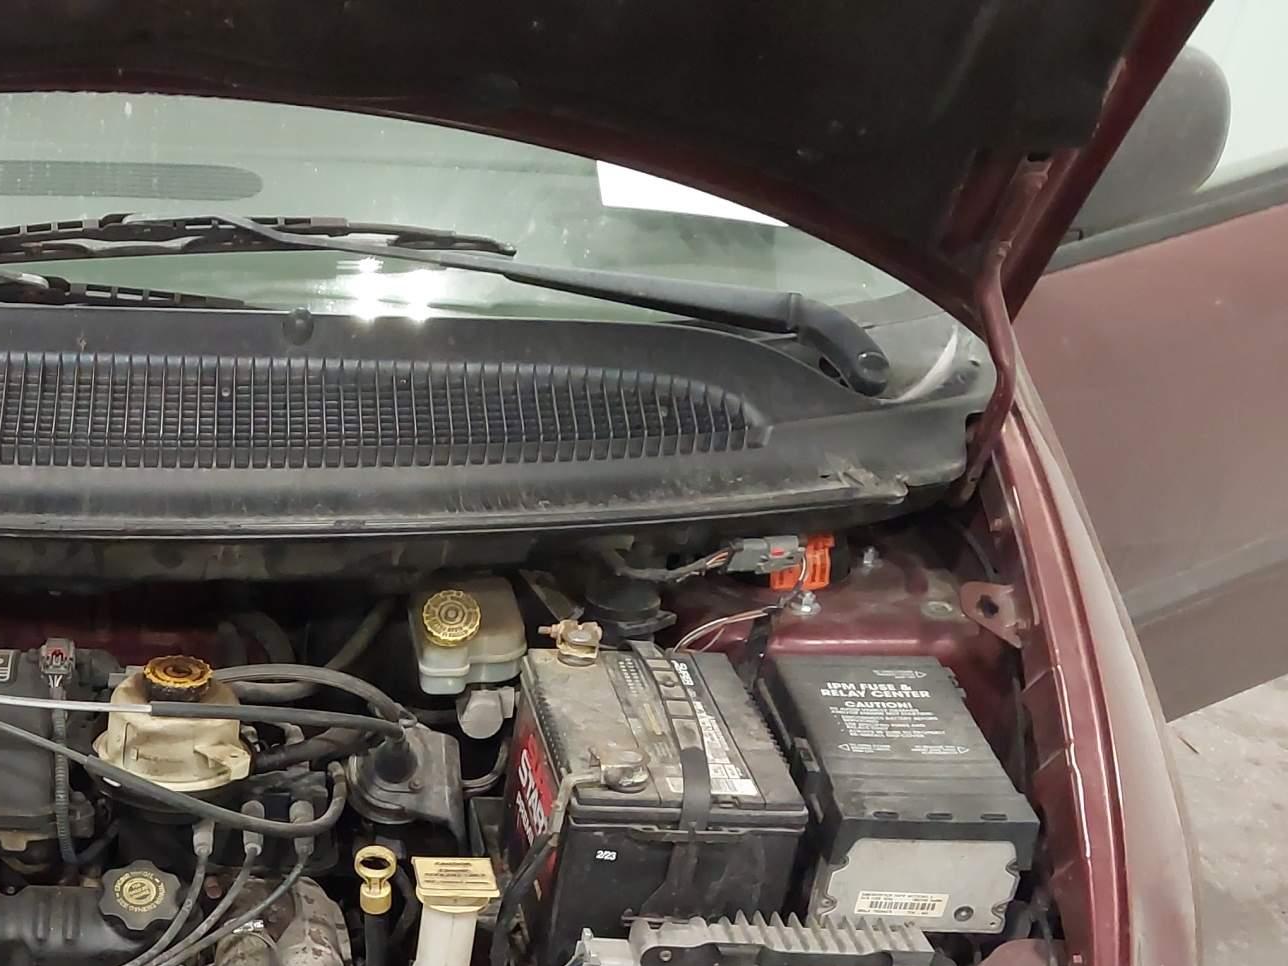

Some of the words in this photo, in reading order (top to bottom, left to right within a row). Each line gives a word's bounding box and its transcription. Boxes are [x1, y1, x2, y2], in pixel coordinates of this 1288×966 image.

[827, 682, 857, 691] IPM
[859, 683, 896, 692] FUSE
[820, 688, 866, 698] RELAY
[871, 690, 931, 698] CENTER
[845, 700, 913, 709] CAUTION!
